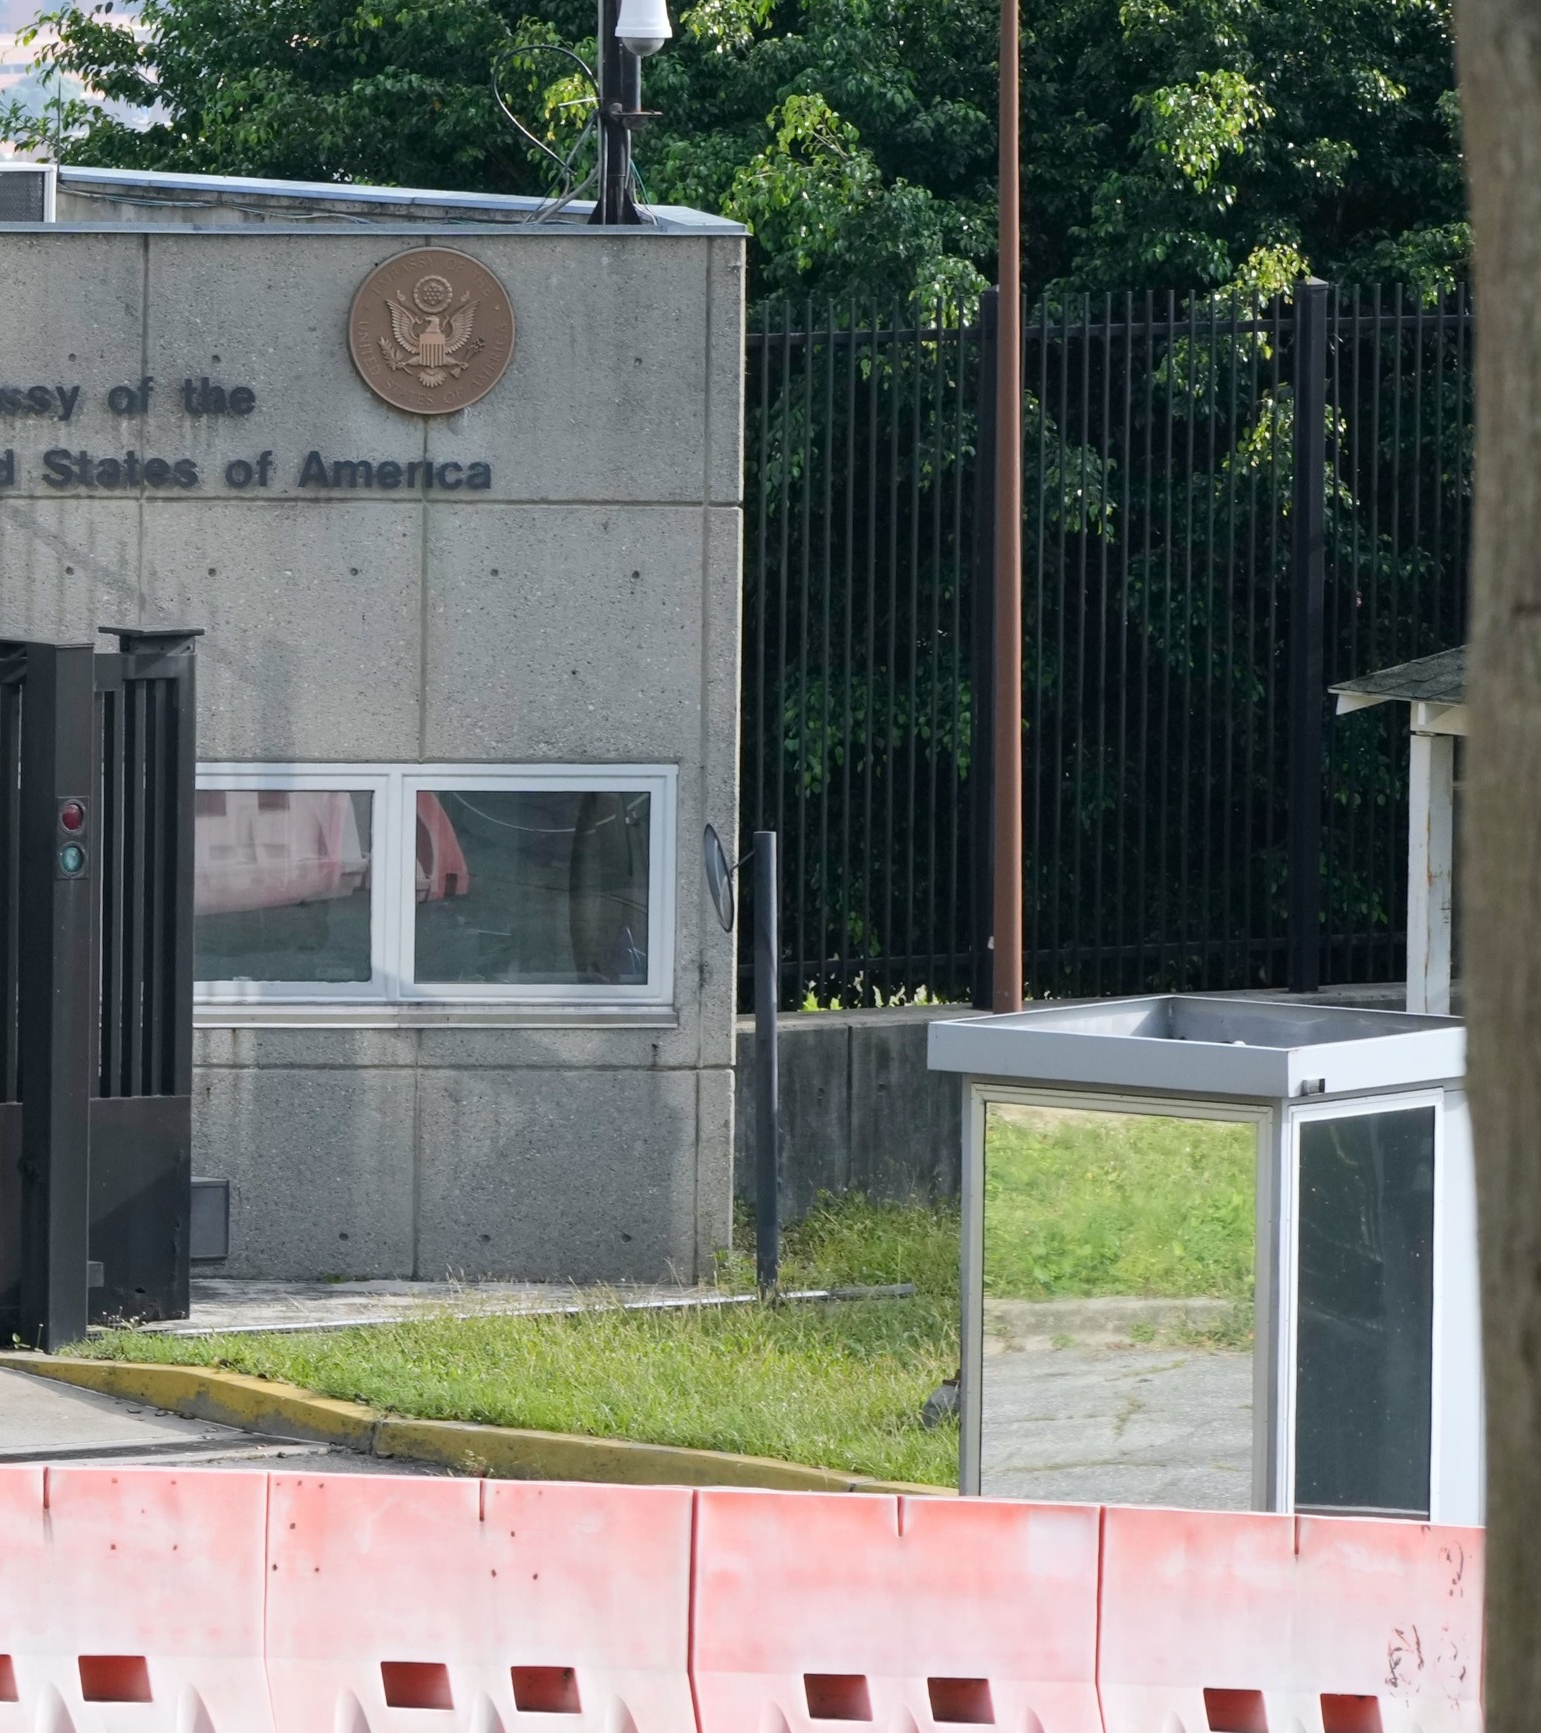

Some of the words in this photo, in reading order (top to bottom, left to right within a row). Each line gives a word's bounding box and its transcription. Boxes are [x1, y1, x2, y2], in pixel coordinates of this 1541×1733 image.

[444, 257, 465, 272] OF
[108, 376, 154, 416] of
[184, 377, 256, 416] the
[41, 448, 198, 490] States
[225, 450, 272, 490] of
[297, 450, 492, 489] America
